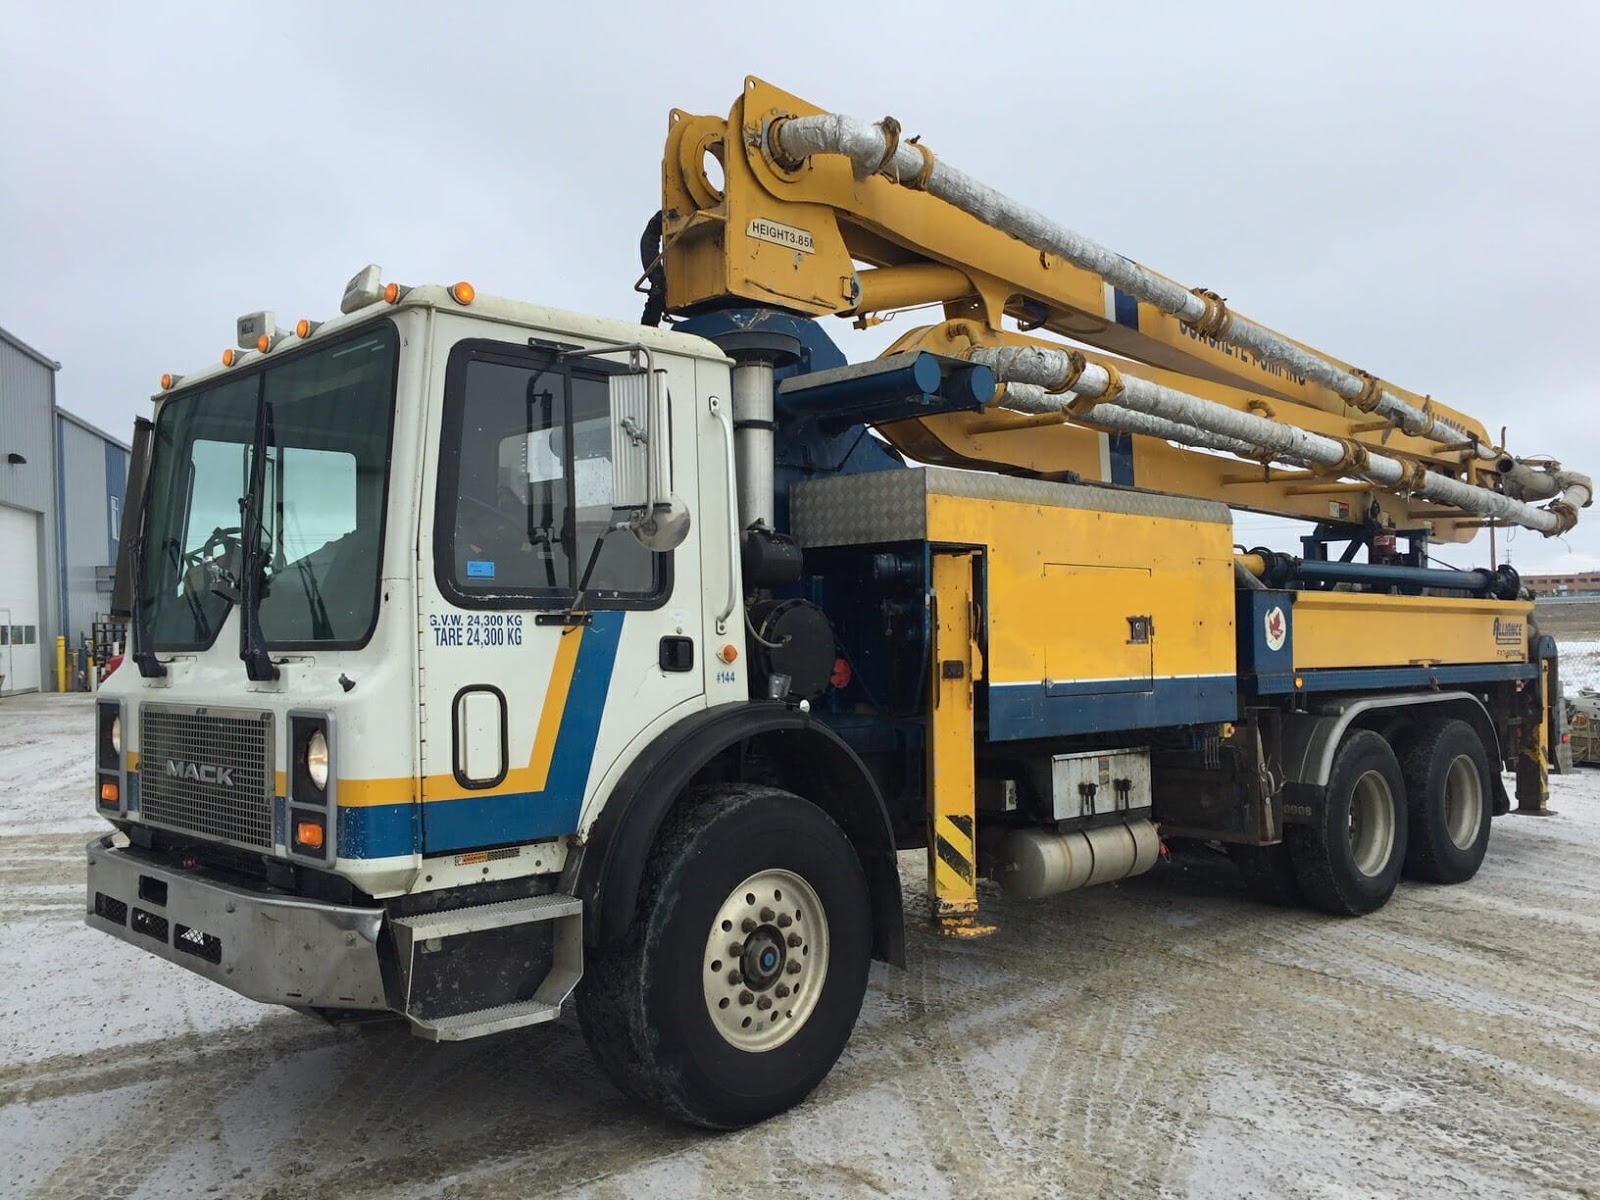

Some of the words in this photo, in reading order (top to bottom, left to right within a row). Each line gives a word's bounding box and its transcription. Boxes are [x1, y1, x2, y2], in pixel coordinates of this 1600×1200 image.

[429, 614, 464, 627] G.V.W.
[467, 614, 504, 628] 24,300
[506, 614, 523, 627] KG
[433, 627, 463, 646] TARE
[466, 627, 504, 648] 24,300
[507, 627, 522, 646] KG
[166, 759, 234, 786] MACK
